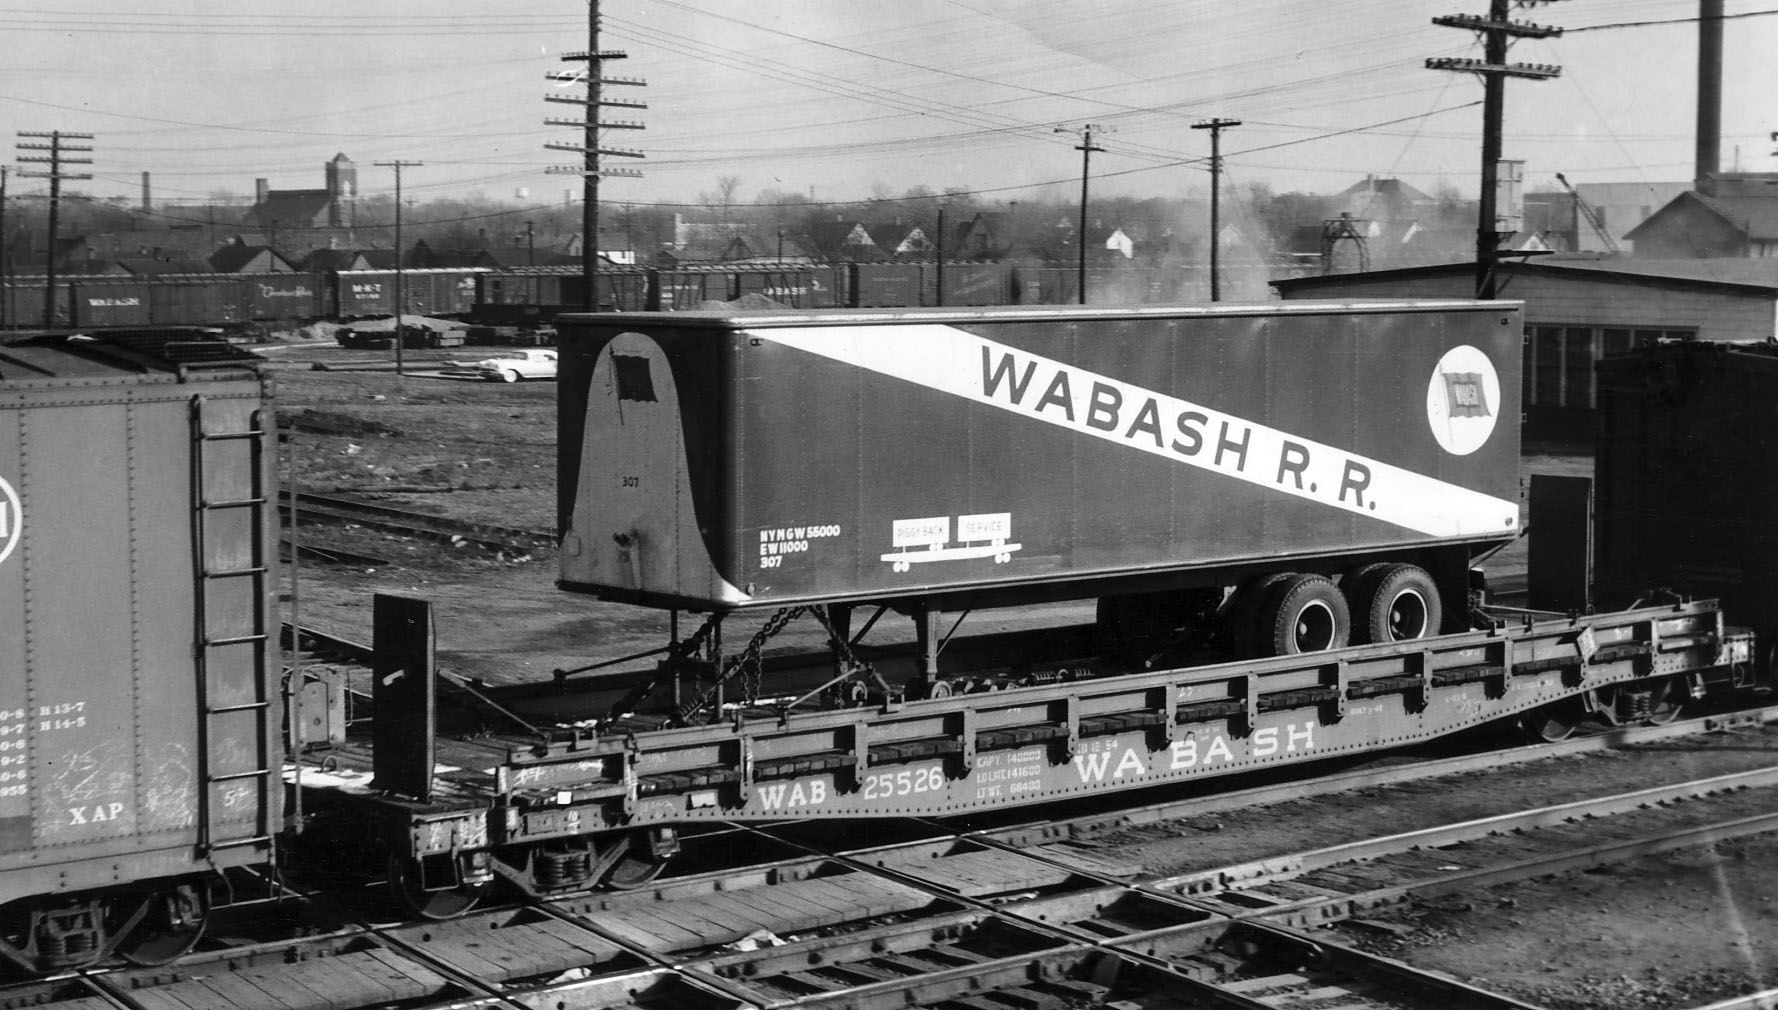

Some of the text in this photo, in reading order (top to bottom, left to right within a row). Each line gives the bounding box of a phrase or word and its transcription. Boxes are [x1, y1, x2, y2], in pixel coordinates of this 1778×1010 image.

[981, 344, 1376, 511] WABASH R. R.
[621, 475, 639, 489] 307
[760, 555, 783, 569] 307
[1074, 720, 1315, 783] WABASH
[758, 766, 944, 811] WAB 25526
